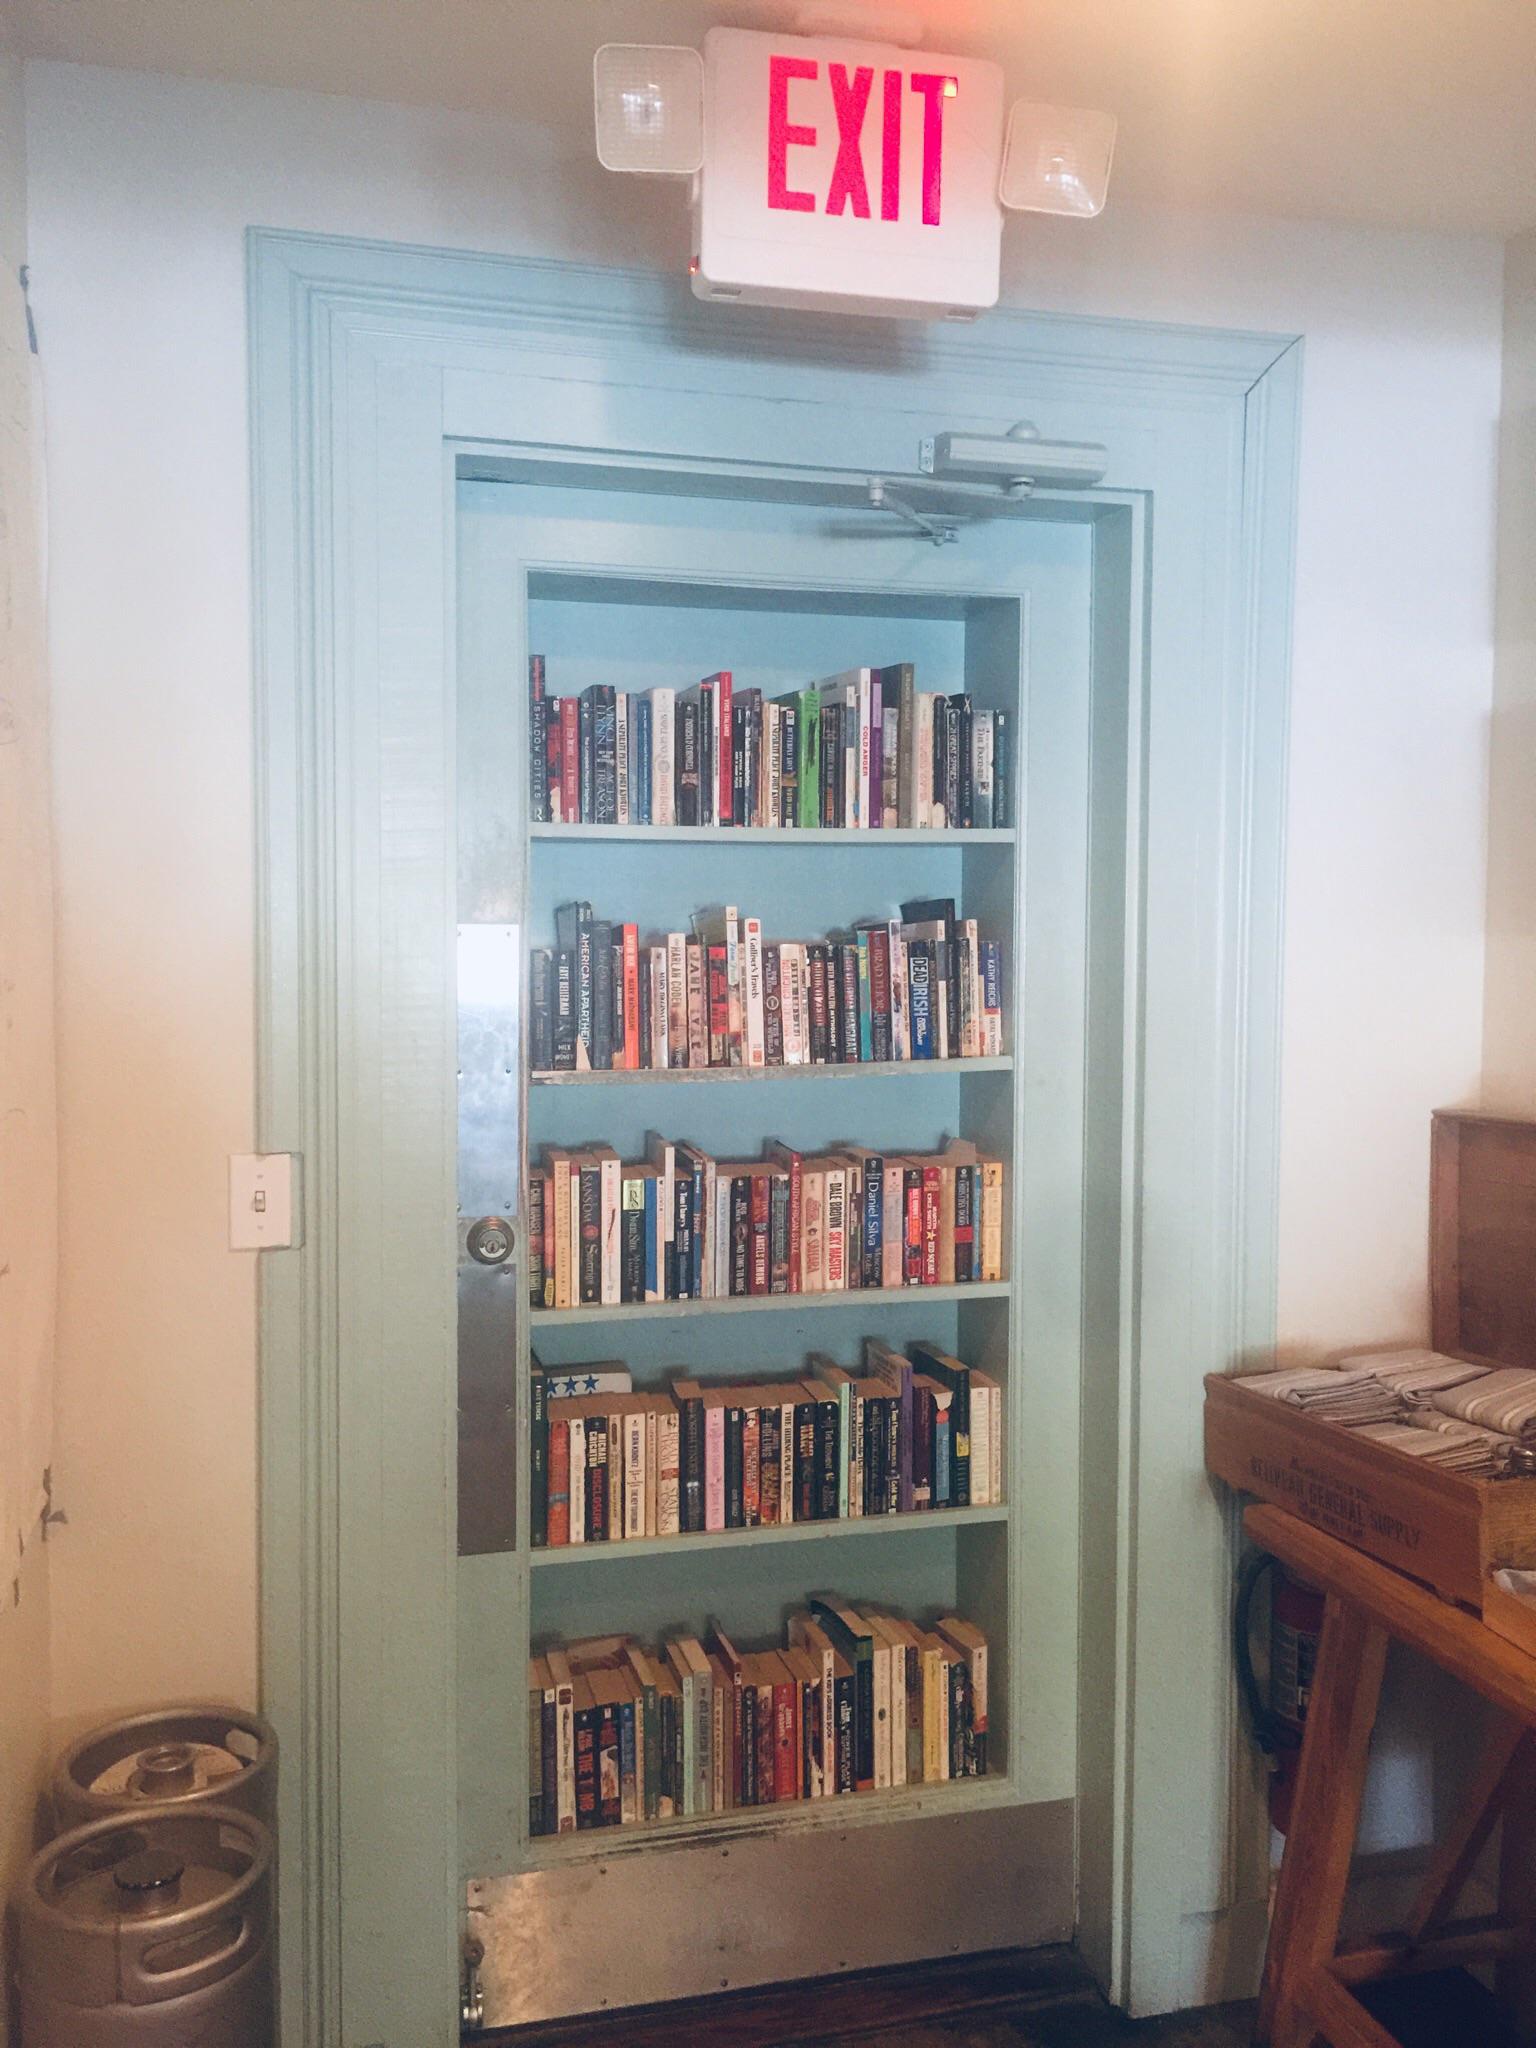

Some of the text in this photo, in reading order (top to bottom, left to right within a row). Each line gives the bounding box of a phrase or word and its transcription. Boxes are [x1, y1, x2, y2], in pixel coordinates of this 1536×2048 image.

[768, 55, 959, 227] EXIT
[597, 705, 606, 744] FLYNN
[606, 705, 614, 743] VINCE
[597, 770, 606, 818] TREASON
[581, 933, 590, 1048] AMERICAN APARTHEID
[671, 947, 682, 1008] HARLAN COBEN
[690, 952, 701, 995] JANE
[750, 938, 759, 999] Gulliver's Travels
[912, 959, 928, 1016] DEAD IRISH
[987, 960, 996, 1006] KATHY REICHS
[583, 1175, 592, 1222] SANSOM
[868, 1182, 879, 1246] Daniel Silva
[756, 1235, 765, 1257] ANGELS
[829, 1183, 842, 1281] DALE BROWN SKY MASTERS
[807, 1239, 819, 1274] SAHARA
[927, 1254, 935, 1275] SQUARE
[588, 1431, 597, 1467] CRICHTON
[597, 1433, 606, 1464] MICHAEL
[592, 1469, 601, 1529] DISCLOSURE
[580, 1753, 594, 1812] THE TMB
